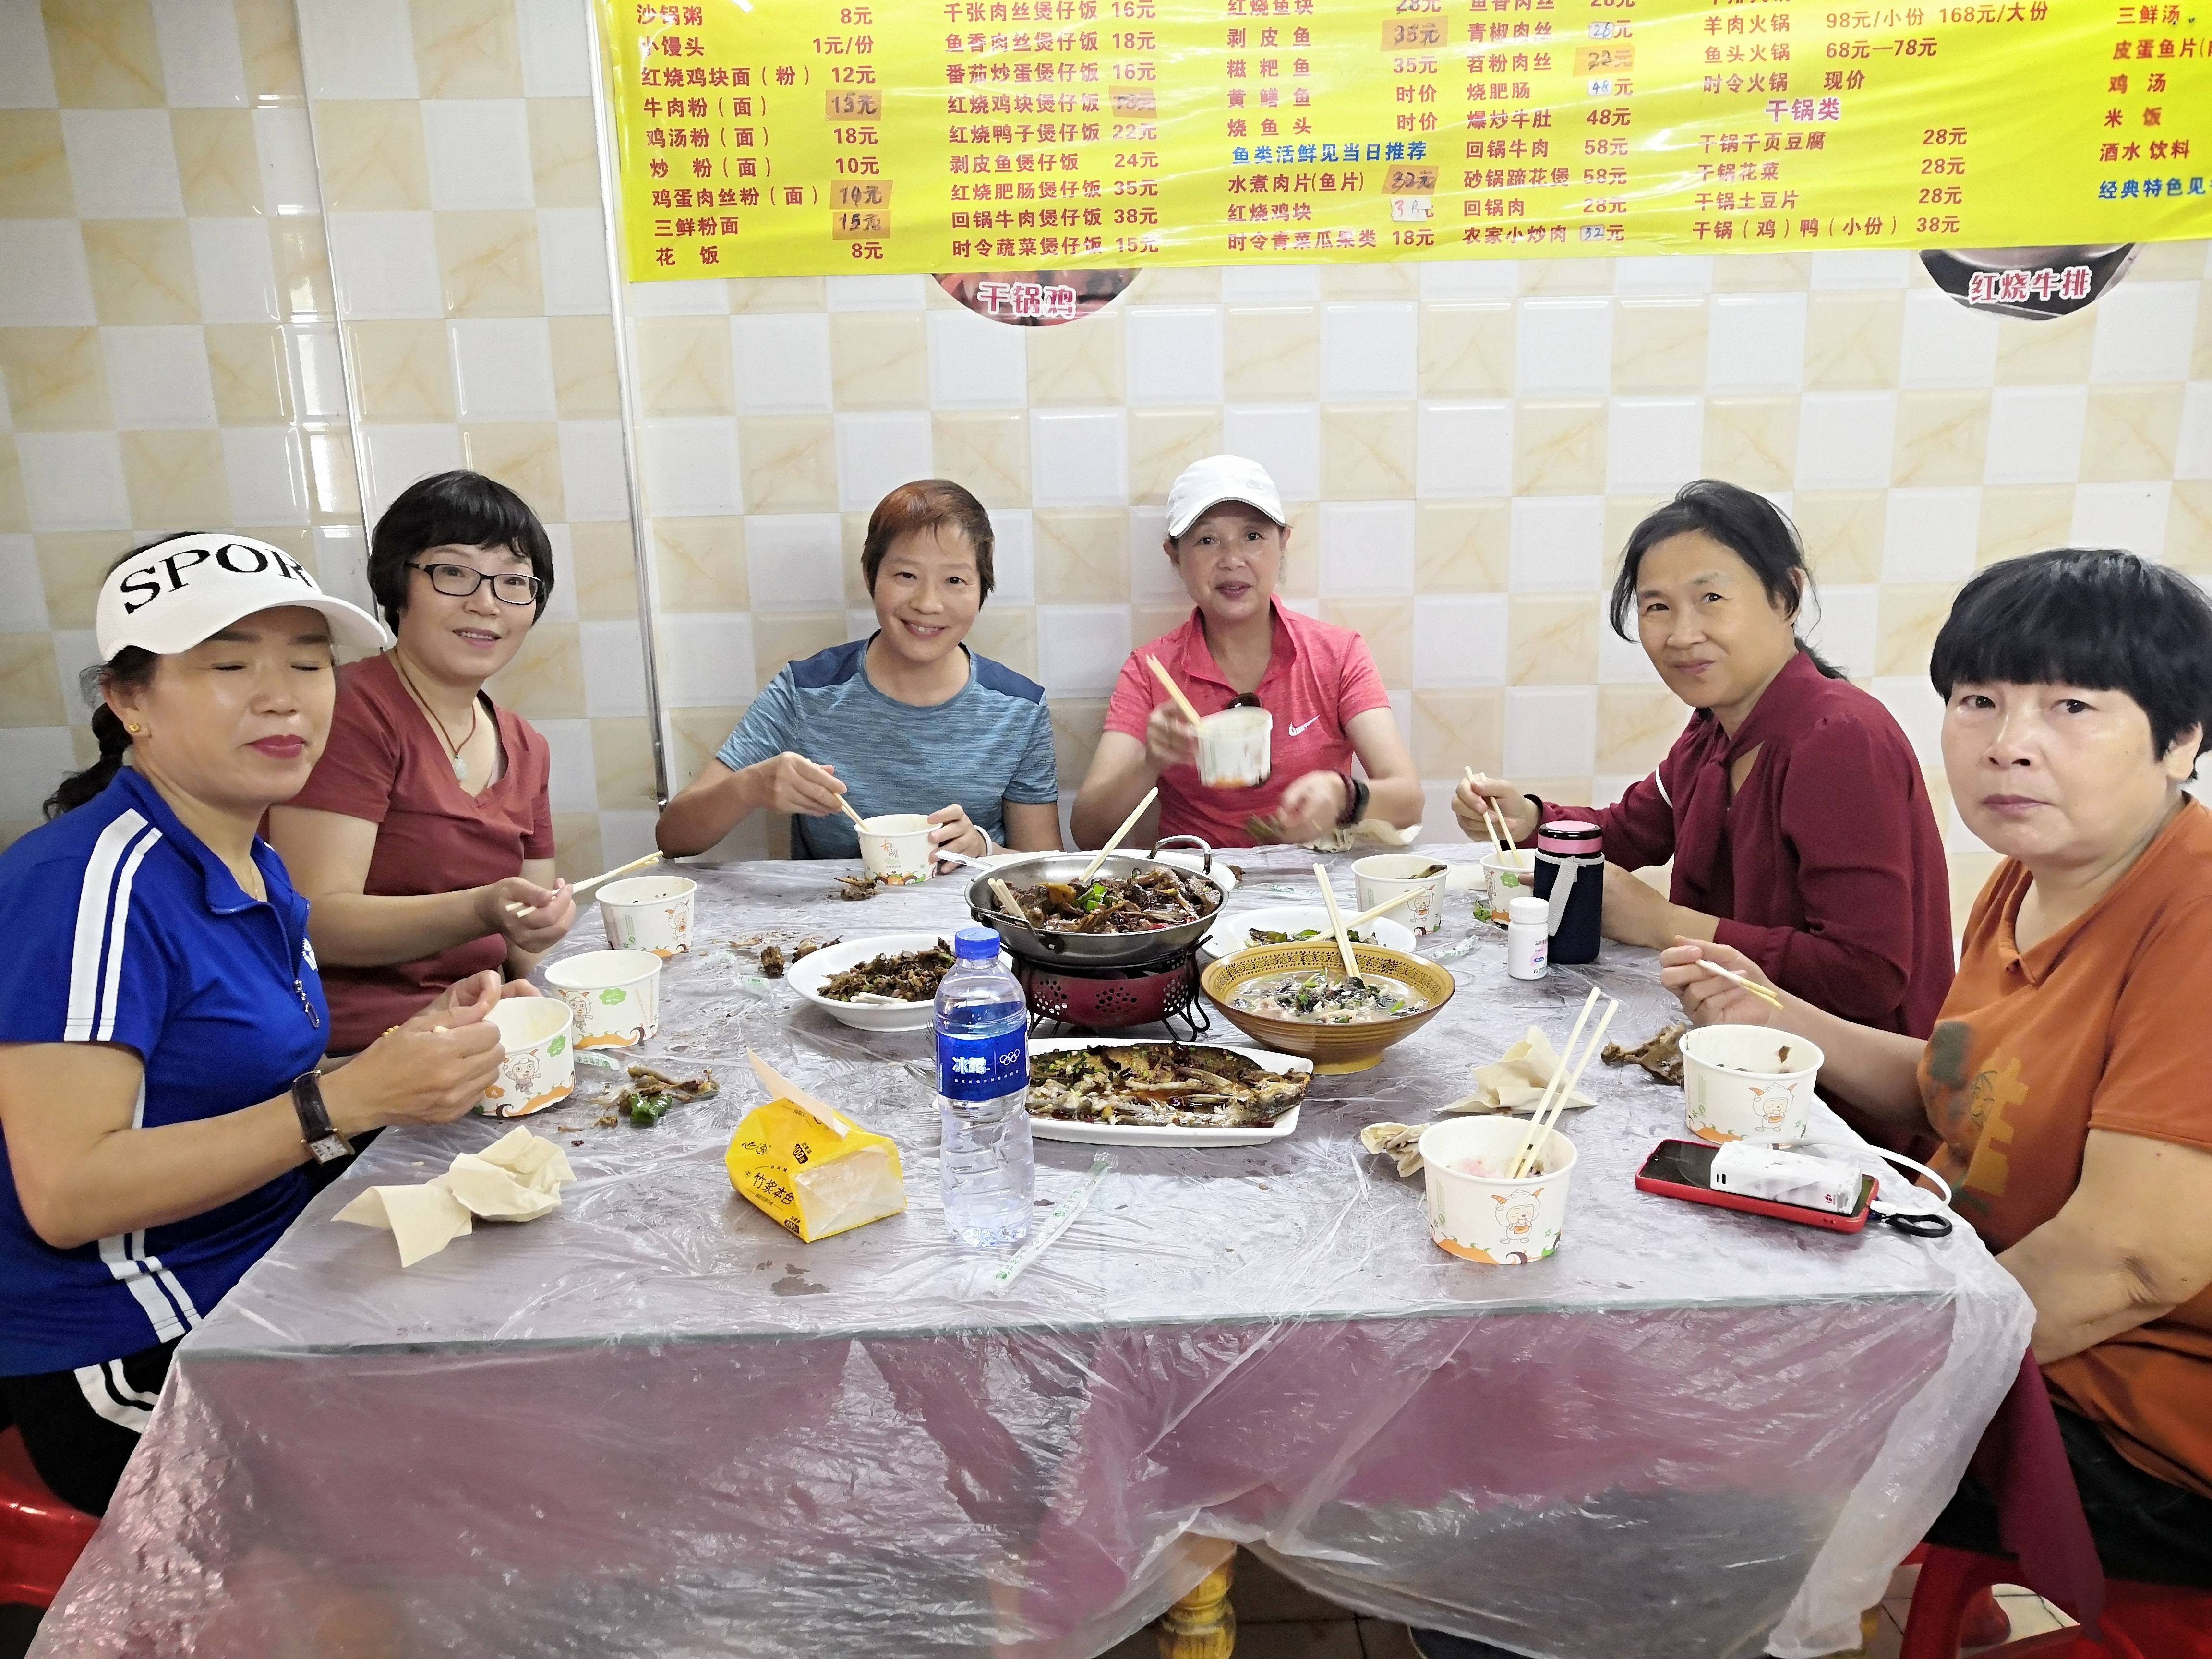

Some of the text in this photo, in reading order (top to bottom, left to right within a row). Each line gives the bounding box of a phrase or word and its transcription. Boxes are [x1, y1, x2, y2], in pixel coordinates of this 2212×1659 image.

[636, 4, 873, 26] 沙锅粥 8元
[943, 0, 1156, 23] 千张肉丝煲仔饭 16元
[1704, 1, 2048, 35] 羊肉火锅 98元/小份 168元/大份
[2116, 4, 2181, 24] 三鲜汤
[945, 31, 1156, 53] 鱼香肉丝煲仔饭 18元
[1227, 26, 1312, 48] 剥皮鱼
[1468, 22, 1552, 43] 青椒肉丝
[639, 35, 874, 57] 小馒头 1元/份
[1704, 43, 1791, 64] 鱼头火锅
[2112, 38, 2212, 60] 皮蛋鱼片(
[831, 65, 876, 84] 12元
[945, 62, 1156, 84] 番茄炒蛋煲仔饭 16元
[1393, 56, 1438, 74] 35元
[1467, 82, 1530, 101] 烧肥肠
[1703, 70, 1865, 94] 时令火锅 现价
[948, 93, 1100, 114] 红烧鸡块煲仔饭
[1396, 84, 1437, 104] 时价
[1467, 108, 1631, 130] 爆炒牛肚 48元
[1765, 98, 1841, 123] 干锅类
[833, 127, 878, 145] 18元
[949, 123, 1157, 144] 红烧鸭子煲仔饭 22元
[1227, 112, 1438, 138] 烧鱼头 时价
[1466, 138, 1628, 159] 回锅牛肉 58元
[1697, 127, 1968, 154] 干锅千页豆腐 28元
[950, 152, 1159, 174] 剥皮鱼煲仔饭 24元
[1232, 141, 1427, 164] 鱼类活鲜见当日推荐
[835, 157, 880, 175] 10元
[1697, 156, 1965, 182] 干锅花菜 28元
[1464, 167, 1627, 188] 砂锅蹄花煲 58元
[2098, 176, 2212, 200] 经典特色见
[951, 180, 1158, 201] 红烧肥肠煲仔饭 35元
[1695, 186, 1963, 211] 干锅土豆片 28元
[952, 207, 1158, 228] 回锅牛肉煲仔饭 38元
[1227, 202, 1312, 222] 红烧鸡块
[1464, 196, 1627, 217] 回锅肉 28元
[654, 217, 739, 237] 三鲜粉面
[1462, 225, 1567, 245] 农家小炒肉
[1916, 215, 1960, 233] 38元
[851, 242, 883, 260] 8元
[952, 236, 1159, 258] 时令蔬菜煲仔饭 15元
[1227, 229, 1434, 251] 时令青菜瓜果类 18元
[1970, 268, 2091, 302] 红烧牛排
[980, 285, 1074, 315] 干锅鸡
[120, 544, 317, 615] SPOR
[753, 1172, 794, 1205] 竹浆本色
